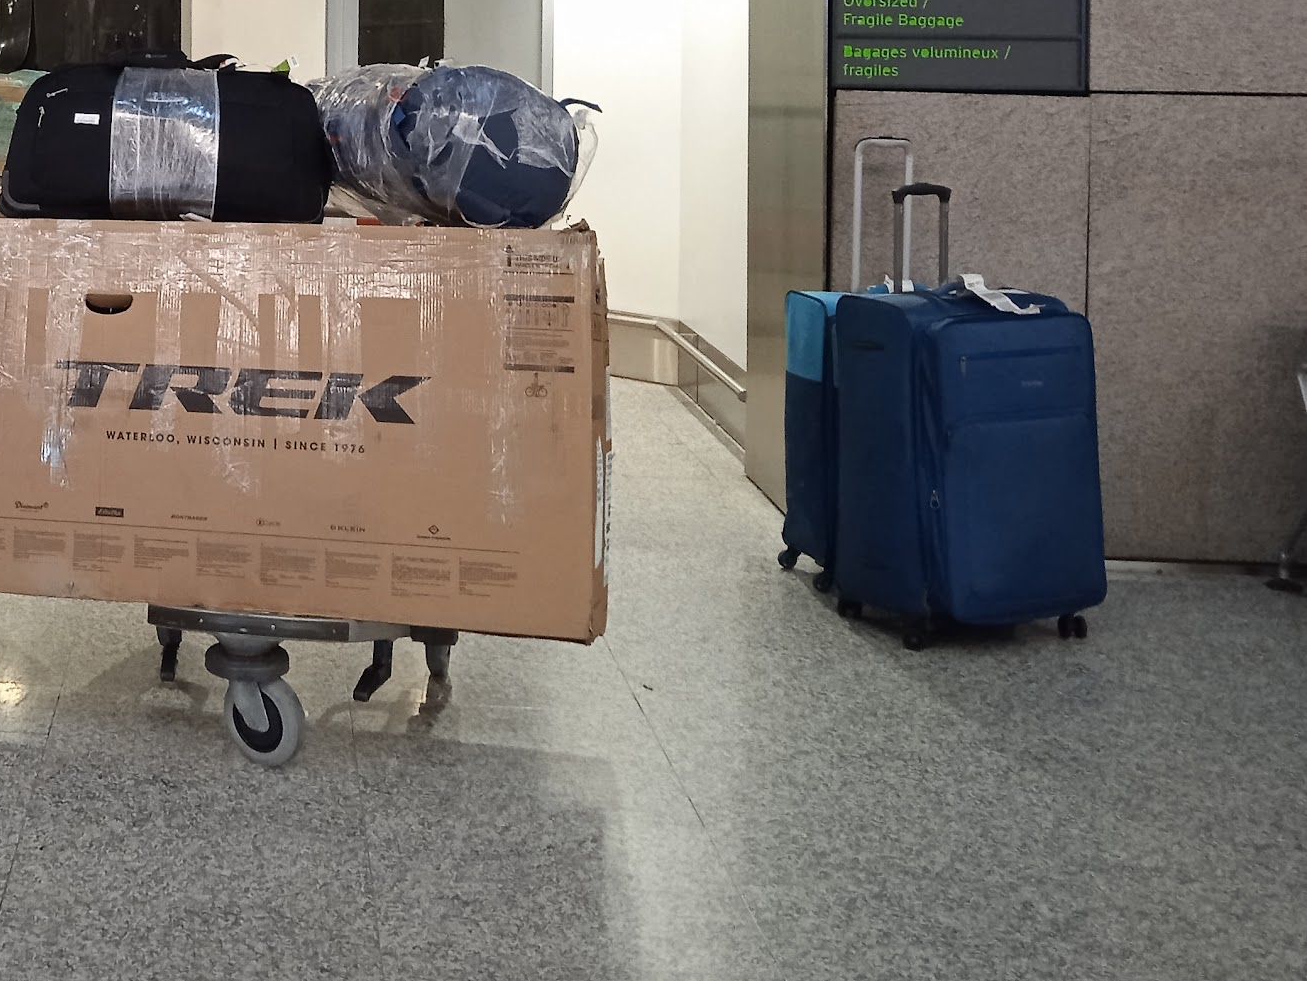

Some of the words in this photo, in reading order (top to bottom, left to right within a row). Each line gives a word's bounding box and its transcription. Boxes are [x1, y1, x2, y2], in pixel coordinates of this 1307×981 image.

[843, 12, 893, 29] Fragile
[898, 13, 964, 29] Baggage
[843, 45, 907, 60] Bagages
[912, 46, 999, 59] volumineux
[843, 64, 899, 79] fragiles
[56, 360, 432, 424] TREK
[106, 430, 180, 445] WATERLOO,
[187, 435, 266, 448] WISCONSIN
[285, 440, 326, 452] SINCE
[334, 443, 366, 454] 1976
